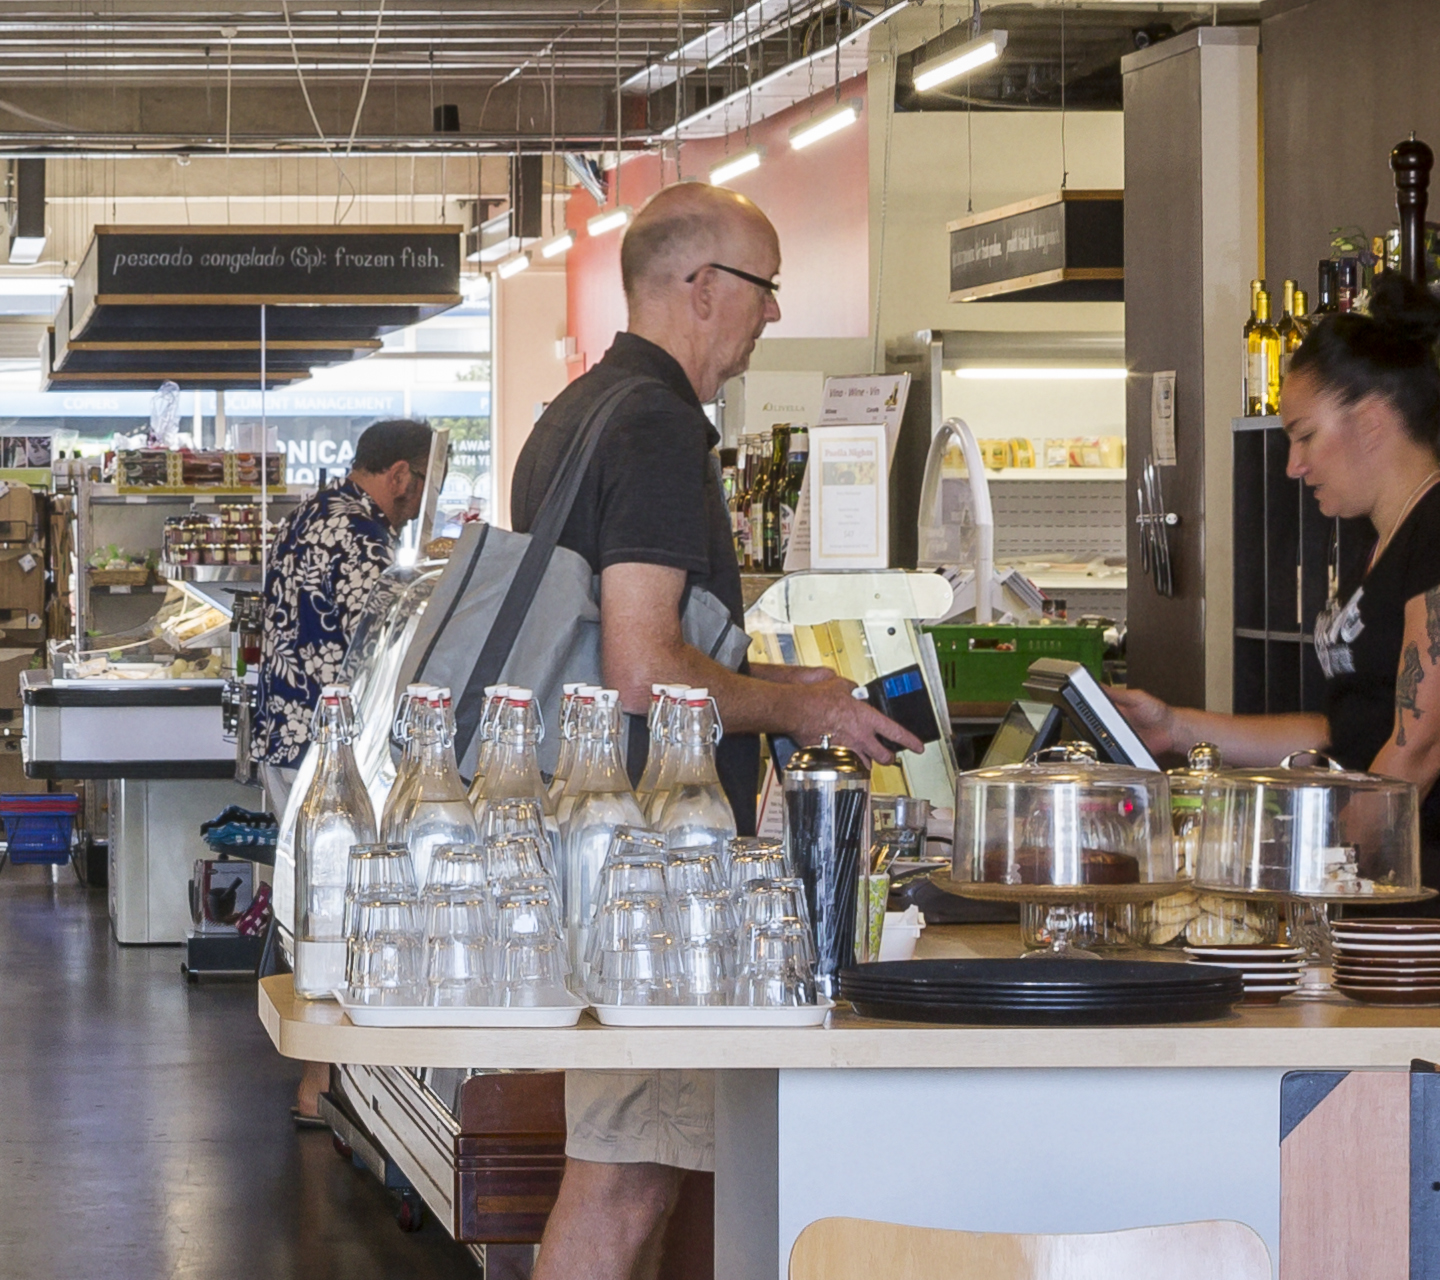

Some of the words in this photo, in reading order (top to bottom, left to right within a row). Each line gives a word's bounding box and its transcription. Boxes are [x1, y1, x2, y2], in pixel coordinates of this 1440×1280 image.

[112, 246, 193, 275] pescado
[200, 246, 285, 274] congelado
[290, 245, 327, 274] (Sp):
[334, 246, 395, 268] frozen
[400, 246, 445, 268] fish.
[848, 387, 864, 397] Wine
[870, 387, 880, 396] Vin
[62, 397, 119, 410] COPIERS
[293, 397, 393, 410] MANAGEMENT
[824, 448, 847, 458] Paella
[848, 448, 874, 459] Nights
